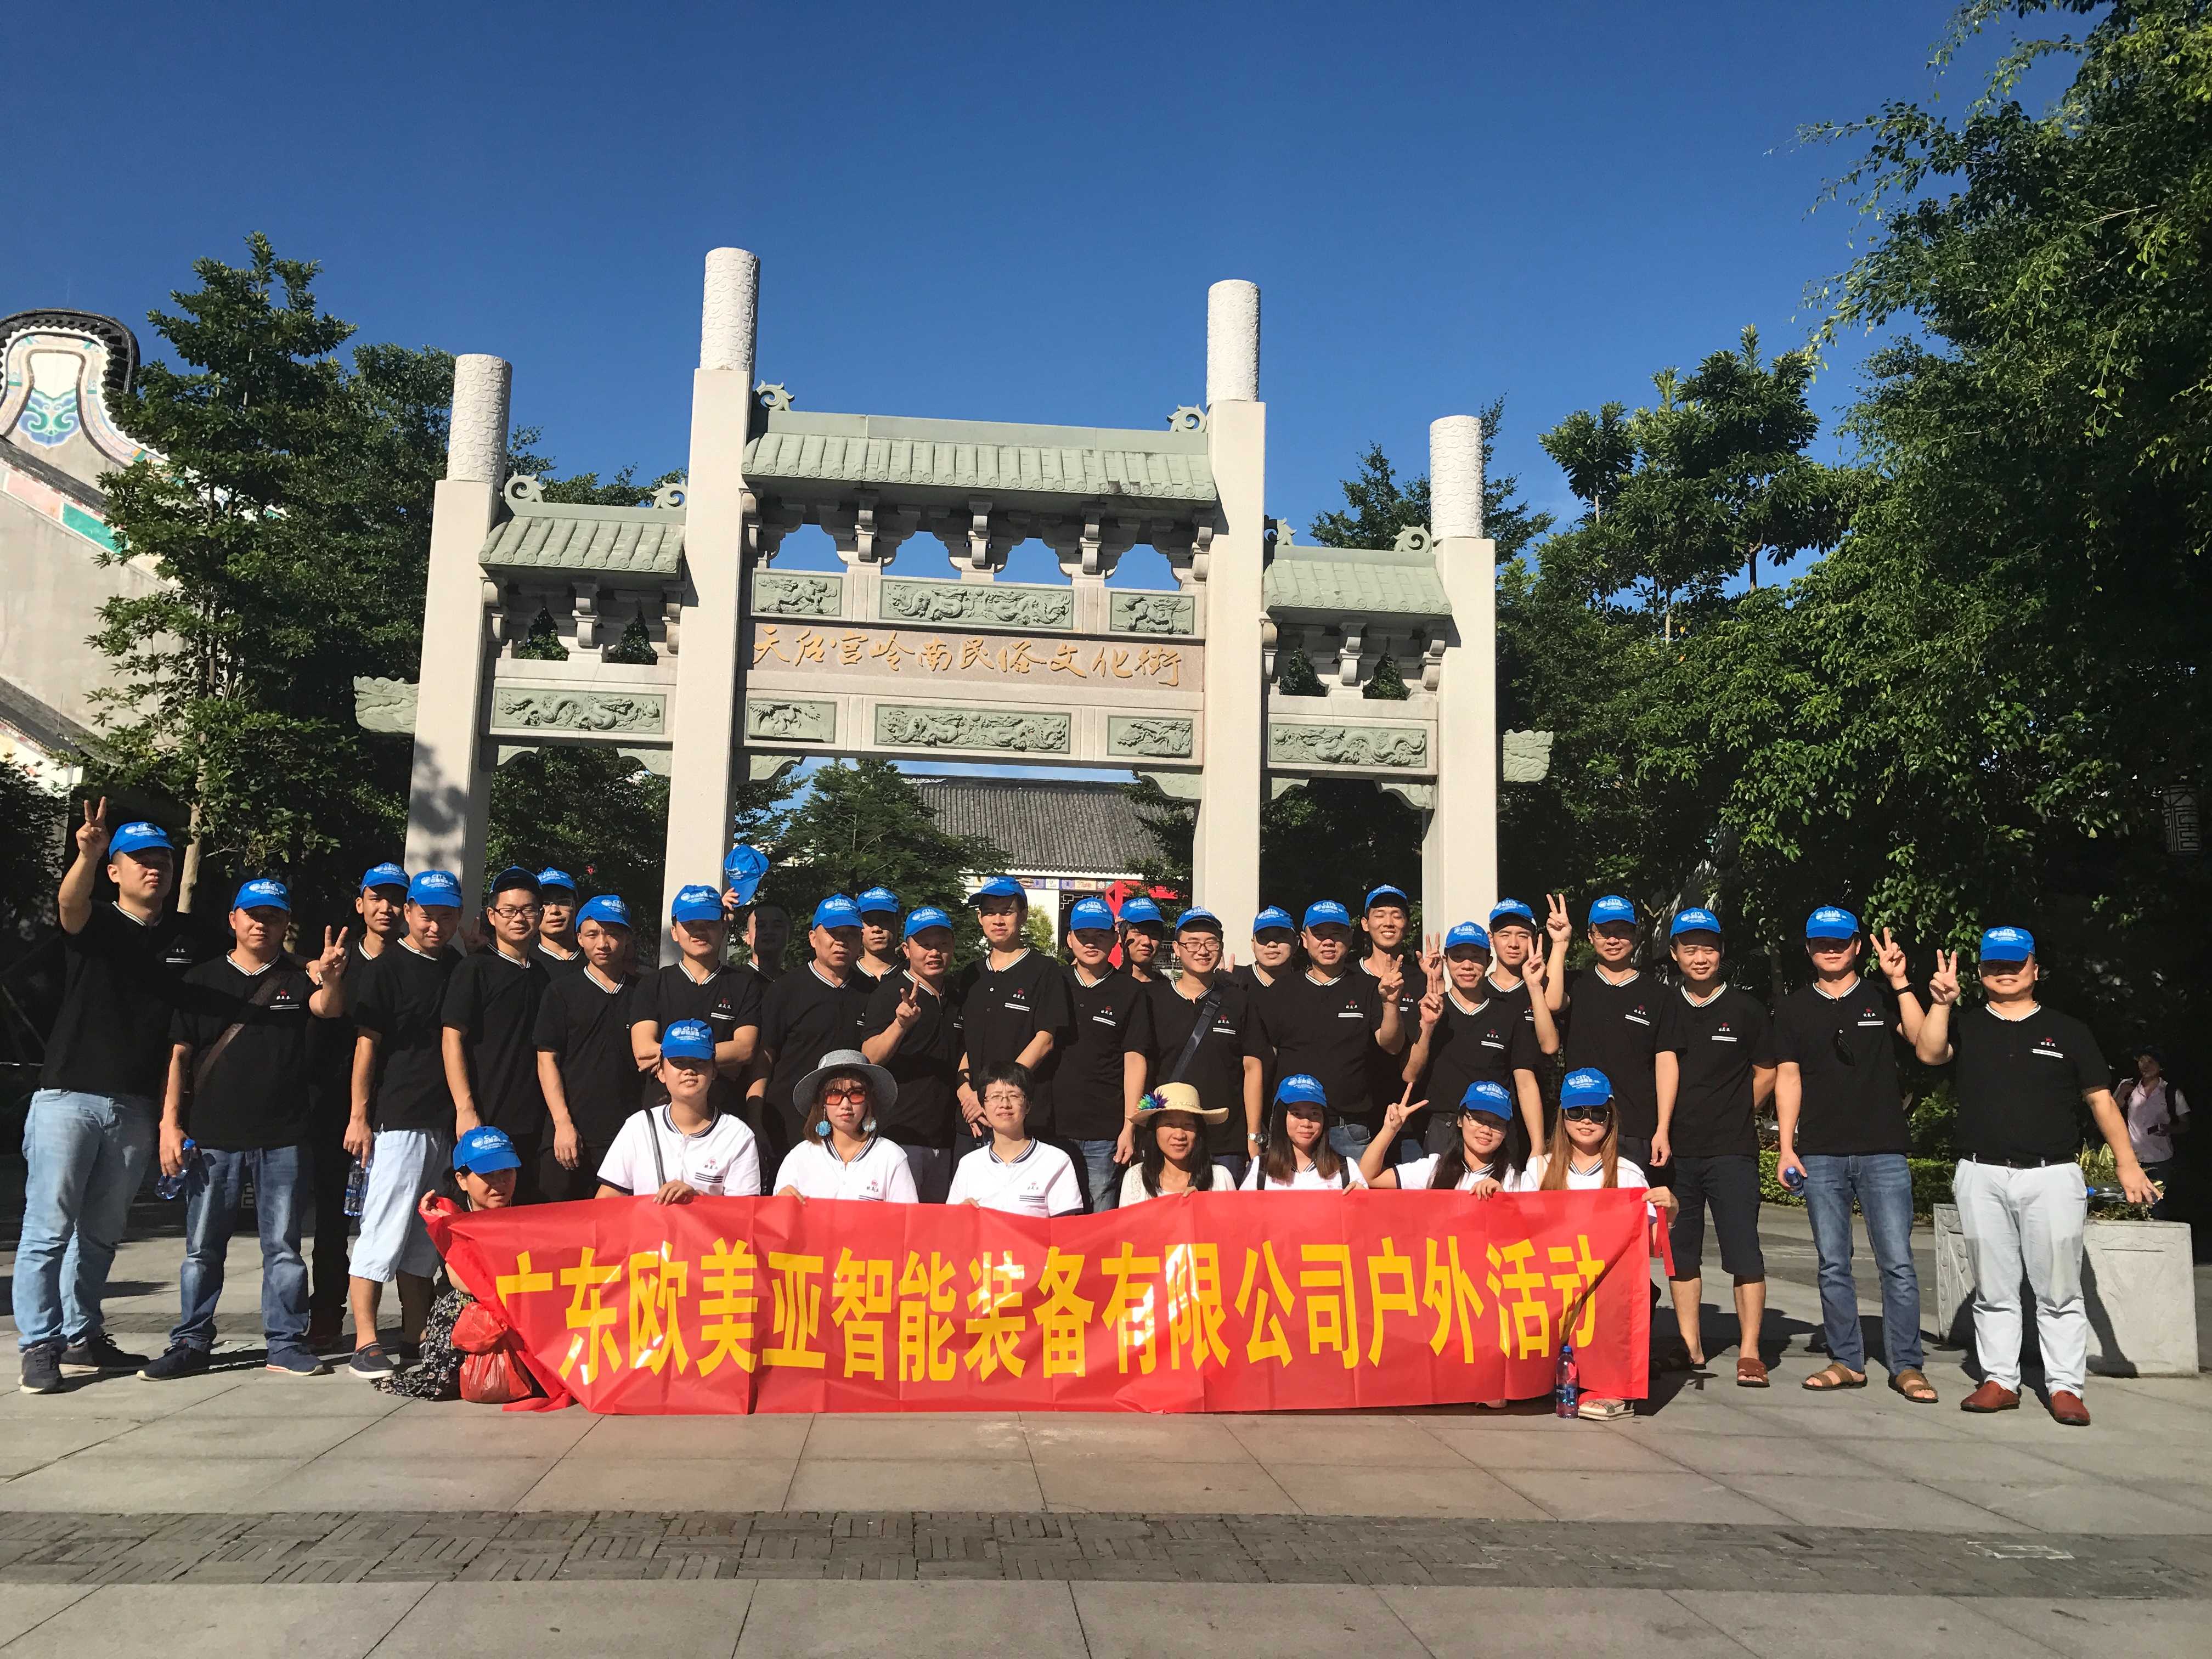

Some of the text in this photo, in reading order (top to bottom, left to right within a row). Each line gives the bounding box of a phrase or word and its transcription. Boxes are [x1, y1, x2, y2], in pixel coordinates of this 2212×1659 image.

[496, 1235, 1605, 1384] 广东欧美亚智能装备有限公司户外活动
